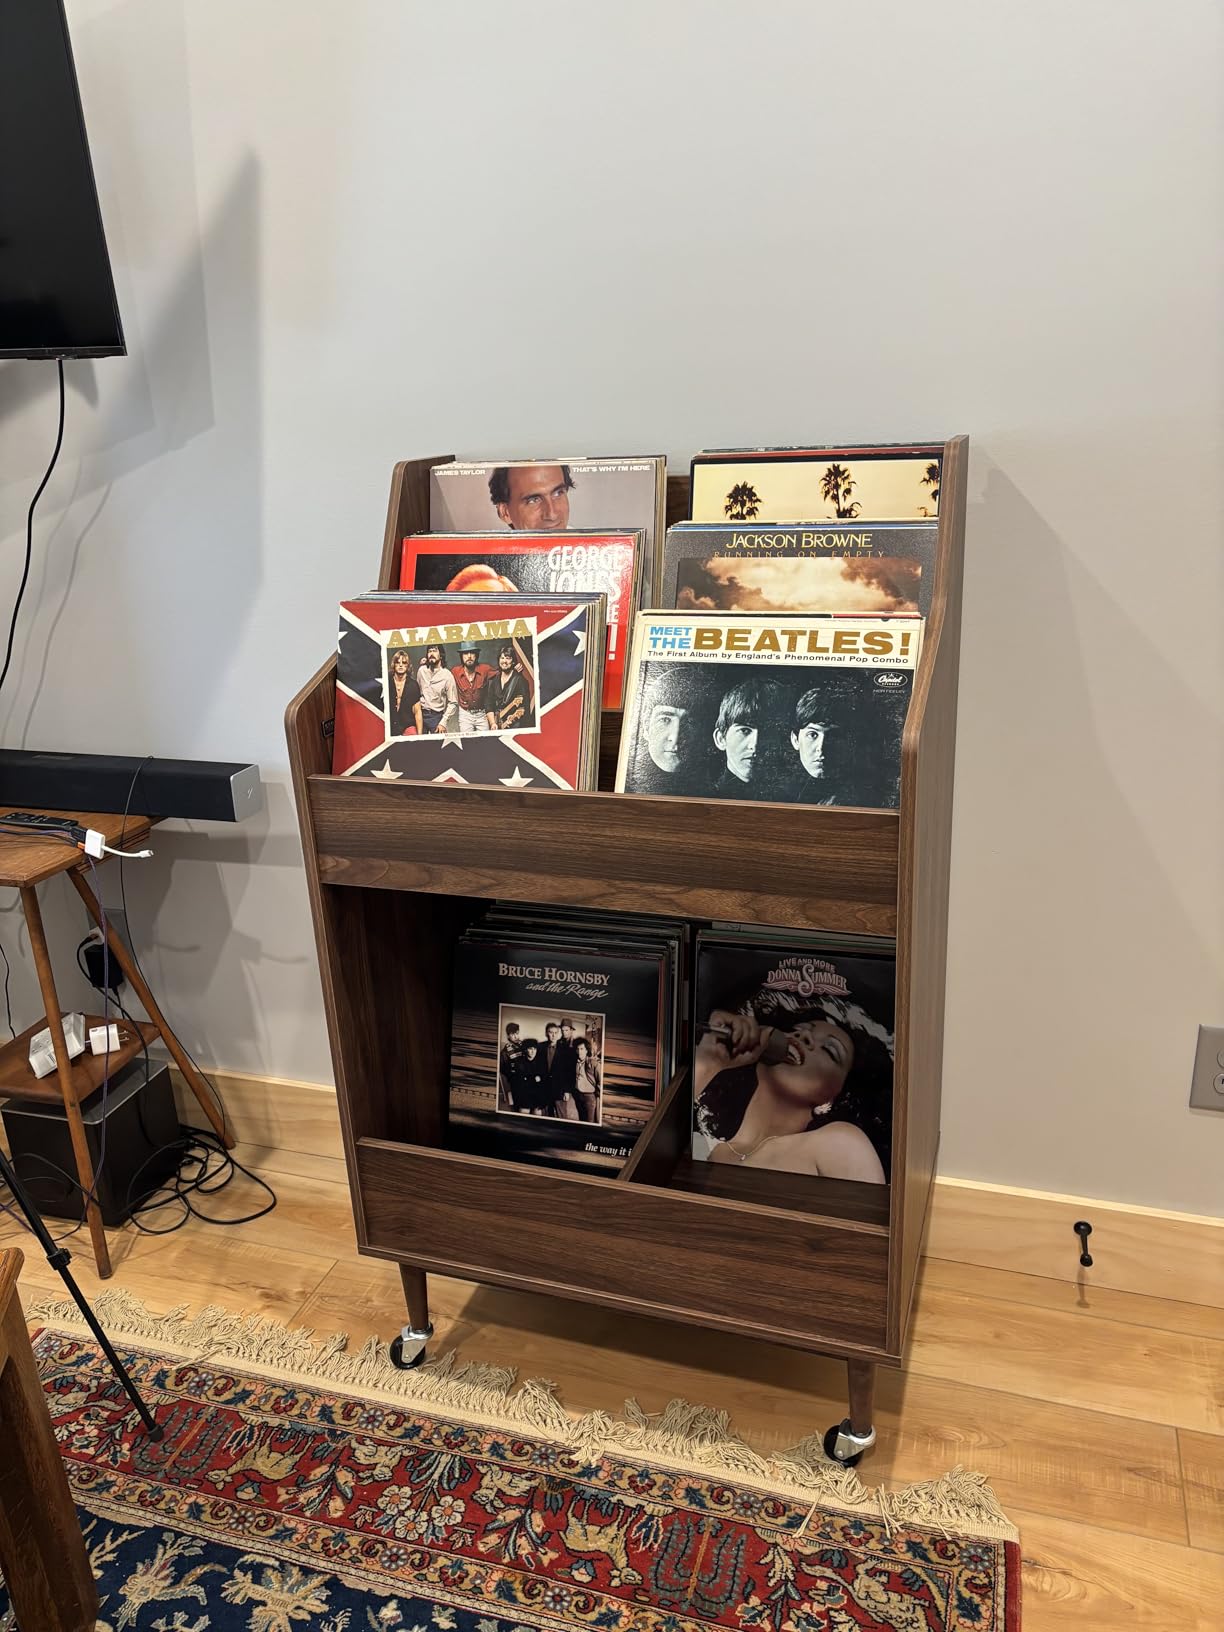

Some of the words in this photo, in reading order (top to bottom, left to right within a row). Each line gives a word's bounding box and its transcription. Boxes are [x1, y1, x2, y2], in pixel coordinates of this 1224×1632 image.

[725, 532, 797, 548] JACKSON
[801, 532, 873, 548] BROWNE
[548, 545, 625, 571] GEORGE
[713, 550, 784, 558] RUNNING
[797, 550, 817, 558] ON
[831, 550, 885, 558] EMPTY
[386, 619, 532, 648] ALABAMA
[649, 626, 692, 636] MEET
[649, 637, 692, 649] THE
[693, 628, 912, 656] BEATLES!
[666, 650, 687, 658] First
[721, 651, 732, 660] by
[735, 652, 781, 661] England's
[784, 653, 846, 662] Phenomenal
[849, 656, 868, 664] Pop
[871, 656, 909, 664] Combo
[778, 957, 797, 969] LIVE
[813, 959, 836, 973] MORE
[499, 963, 542, 979] BRUCE
[544, 967, 610, 986] HORNSBY
[767, 968, 802, 983] DONNA
[797, 963, 848, 998] SUMMER
[525, 981, 546, 992] and
[546, 983, 566, 994] the
[565, 984, 609, 1001] Range
[586, 1142, 598, 1152] the
[600, 1146, 618, 1157] way
[619, 1147, 626, 1156] it
